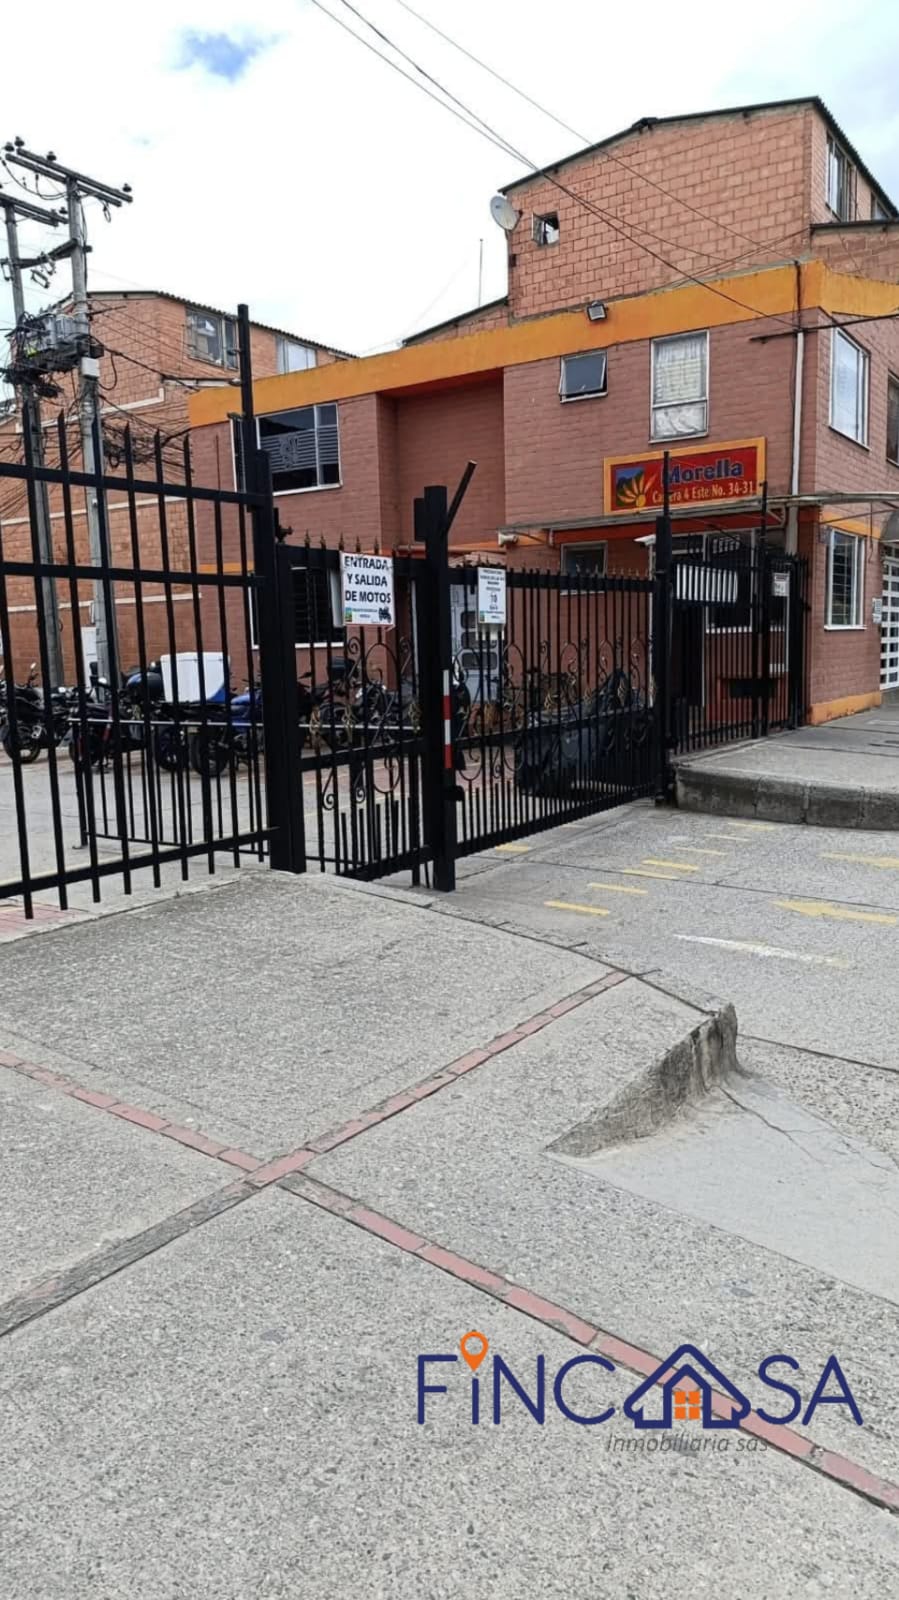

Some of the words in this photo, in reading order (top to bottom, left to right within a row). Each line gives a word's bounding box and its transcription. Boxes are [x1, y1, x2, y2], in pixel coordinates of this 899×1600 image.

[662, 459, 744, 485] Morella
[652, 490, 681, 504] Caera
[683, 487, 689, 500] 4
[692, 486, 710, 499] Este
[711, 483, 726, 497] No.
[728, 480, 754, 495] 34-31
[344, 555, 390, 570] ENTRADA
[347, 573, 353, 585] Y
[354, 573, 388, 587] SALIDA
[345, 590, 357, 601] DE
[359, 591, 391, 604] MOTOS
